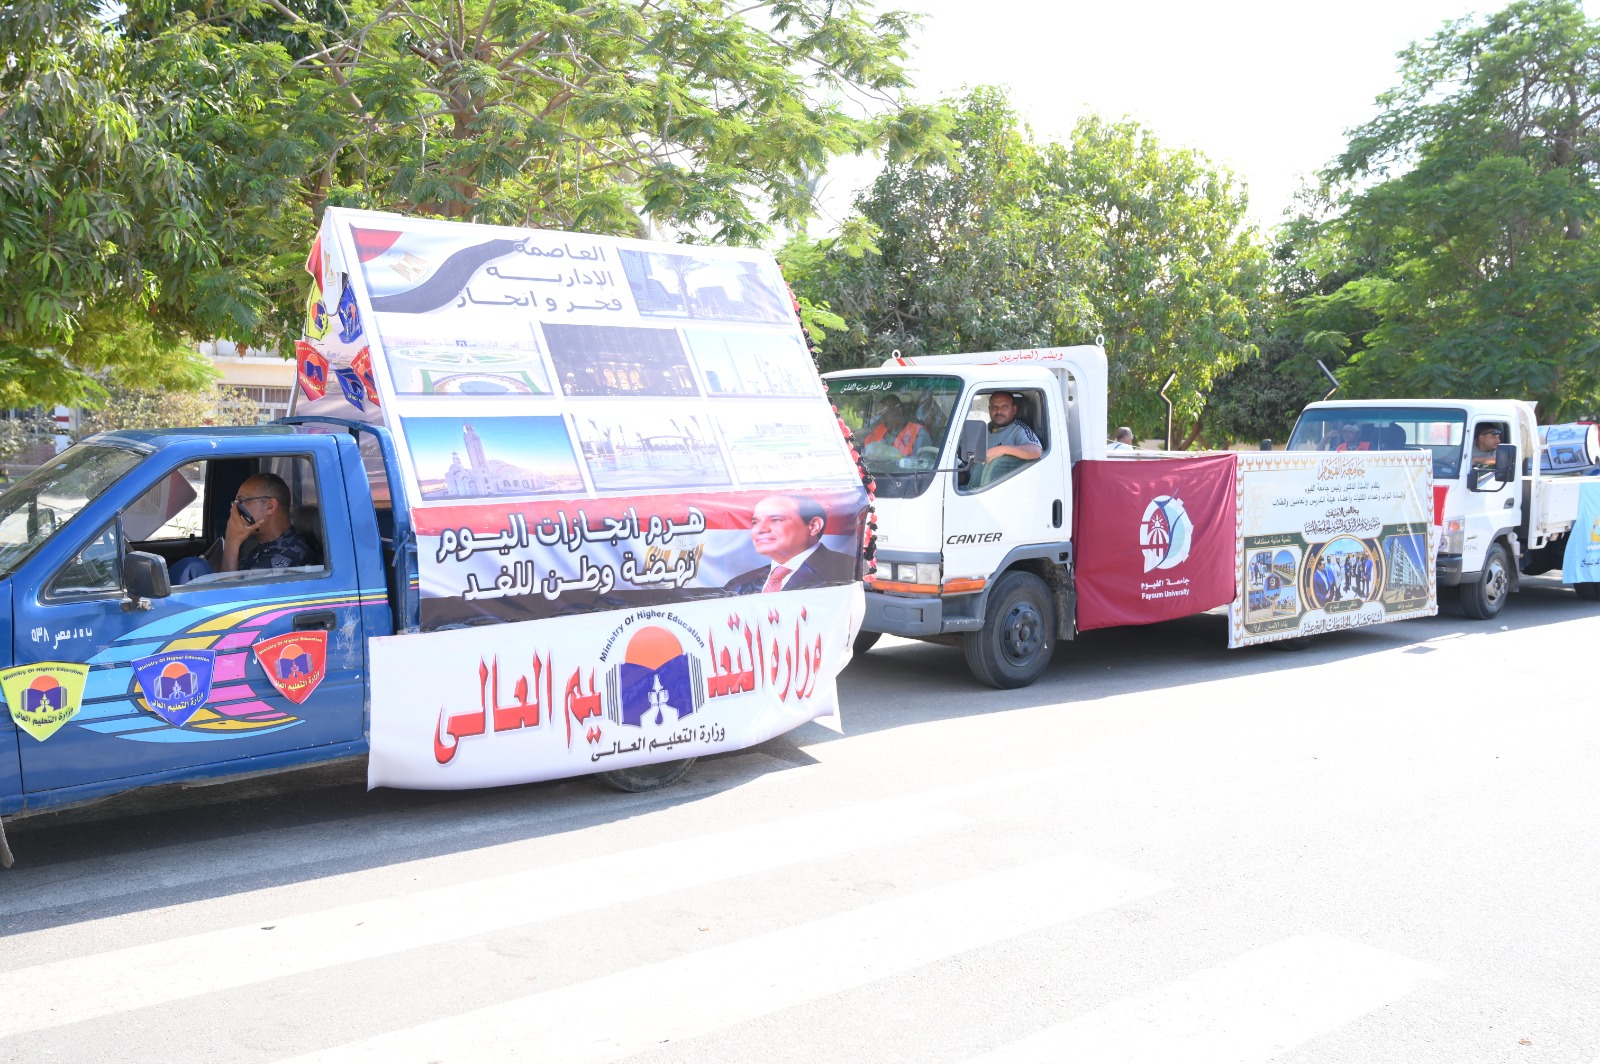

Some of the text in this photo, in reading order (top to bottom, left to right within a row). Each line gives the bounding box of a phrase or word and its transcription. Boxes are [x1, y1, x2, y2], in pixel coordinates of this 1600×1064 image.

[513, 238, 606, 262] العاصمة
[546, 297, 557, 312] و
[566, 293, 623, 313] فخر
[999, 350, 1064, 363] وبشر الصابرين
[882, 380, 892, 390] قل
[436, 506, 706, 564] هرم انجازات اليوم
[946, 532, 1002, 544] CANTER
[462, 550, 697, 602] نهضة وطن للغد
[1141, 577, 1190, 590] جامعة الفيوم
[1142, 588, 1190, 600] Fayoum University
[53, 630, 71, 650] مصر
[600, 608, 706, 662] Ministry Of Higher Education
[768, 606, 822, 703] وزارة
[138, 660, 158, 672] Ministry
[288, 678, 308, 692] التعليم
[168, 700, 189, 712] التعليم
[32, 716, 57, 726] التعليم
[649, 726, 697, 752] التعليم
[699, 722, 726, 742] وزارة
